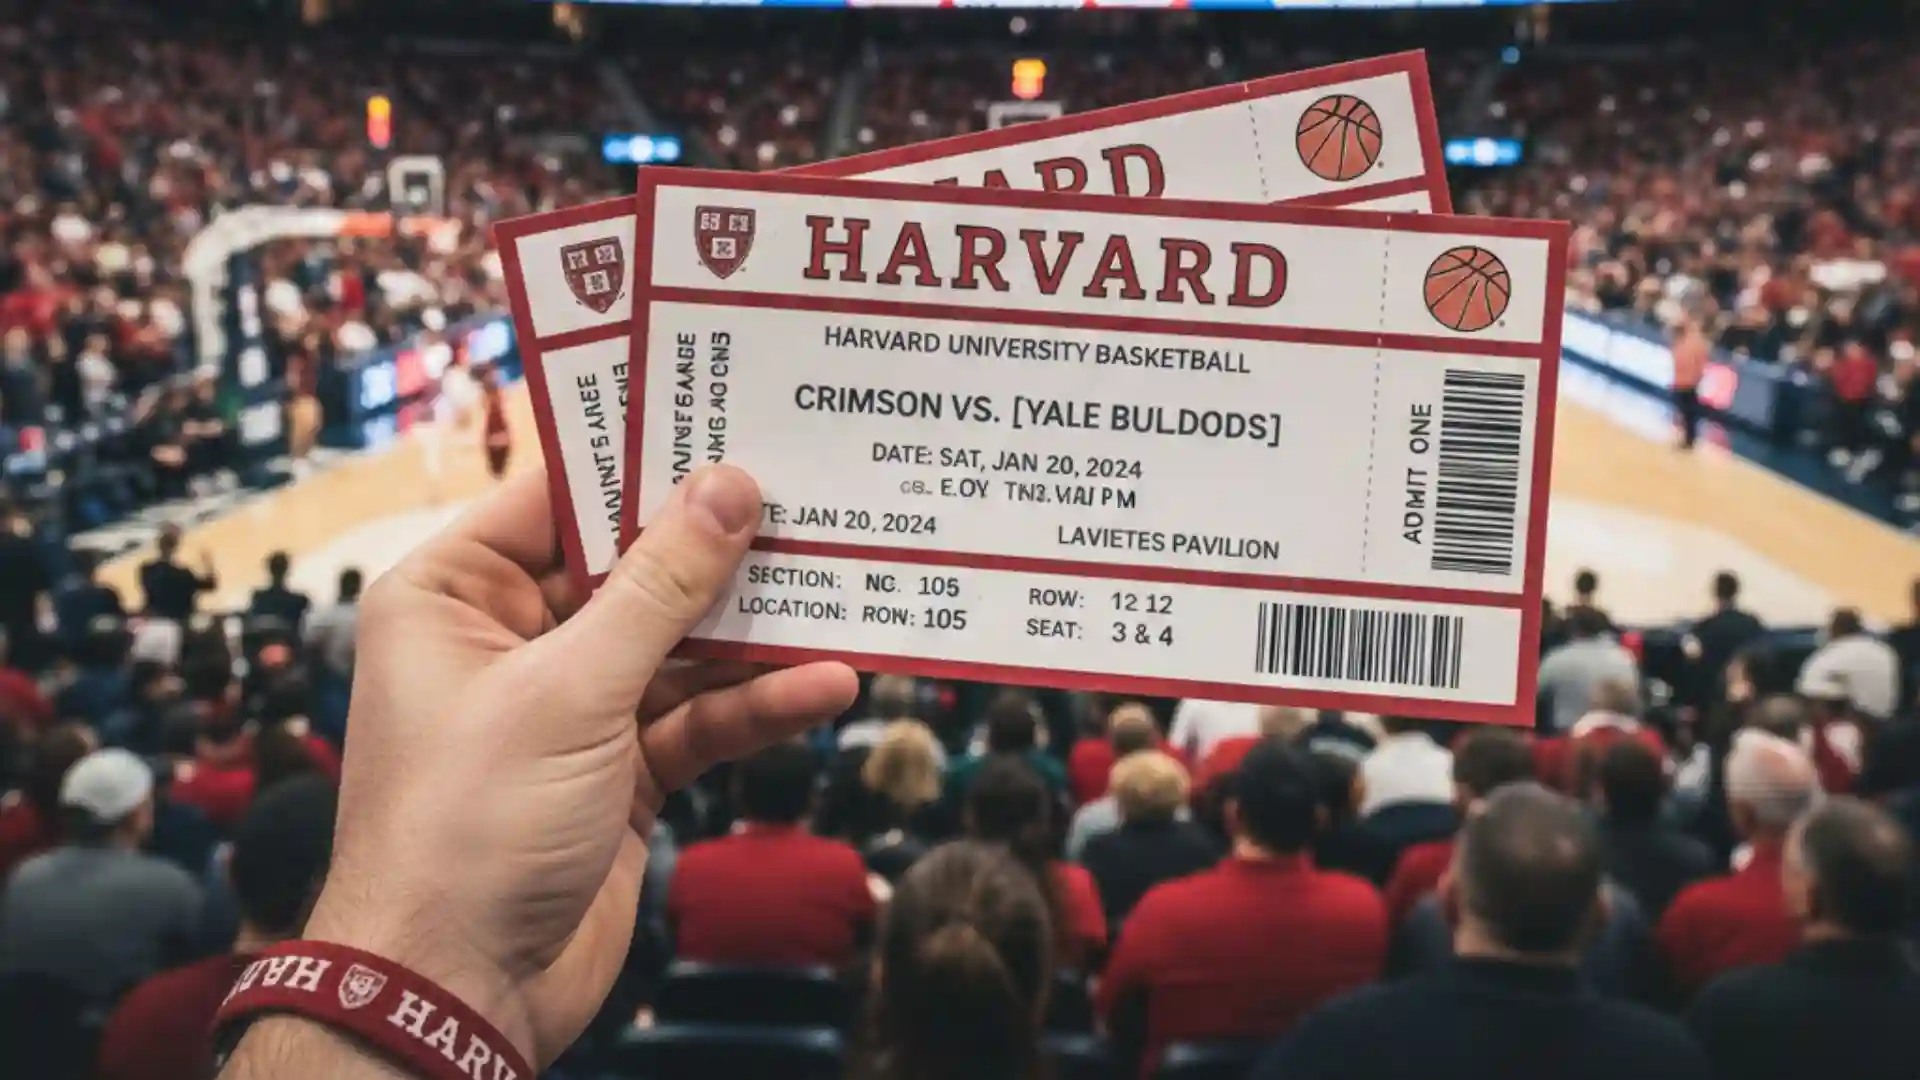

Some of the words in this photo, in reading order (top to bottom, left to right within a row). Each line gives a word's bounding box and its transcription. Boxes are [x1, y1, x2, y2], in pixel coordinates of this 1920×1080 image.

[933, 143, 1166, 198] RD
[802, 212, 1290, 309] HARVARD
[825, 326, 940, 352] HARVARD
[949, 334, 1090, 362] UNIVERSITY
[1096, 344, 1250, 373] BASKETBALL
[795, 384, 942, 419] CRIMSON
[952, 395, 1000, 422] VS.
[1013, 396, 1101, 429] [YALE
[1111, 405, 1281, 448] BULDODS]
[1410, 404, 1431, 454] ONE
[873, 443, 932, 464] DATE:
[940, 448, 985, 472] SAT,
[992, 451, 1037, 472] JAN
[1046, 455, 1079, 478] 20,
[1086, 457, 1142, 479] 2024
[792, 507, 837, 527] JAN
[845, 510, 876, 532] 20,
[883, 513, 936, 534] 2024
[1403, 468, 1427, 544] ADMIT
[1059, 526, 1165, 551] LAVIETES
[1172, 534, 1279, 559] PAVILION
[747, 562, 840, 588] SECTION:
[918, 577, 959, 597] 105
[737, 594, 846, 622] LOCATION:
[924, 608, 966, 630] 105
[1029, 588, 1084, 607] ROW:
[1112, 592, 1137, 611] 12
[1146, 594, 1172, 614] 12
[1027, 618, 1082, 639] SEAT:
[1112, 622, 1126, 642] 3
[1135, 624, 1150, 644] &
[1159, 626, 1173, 646] 4
